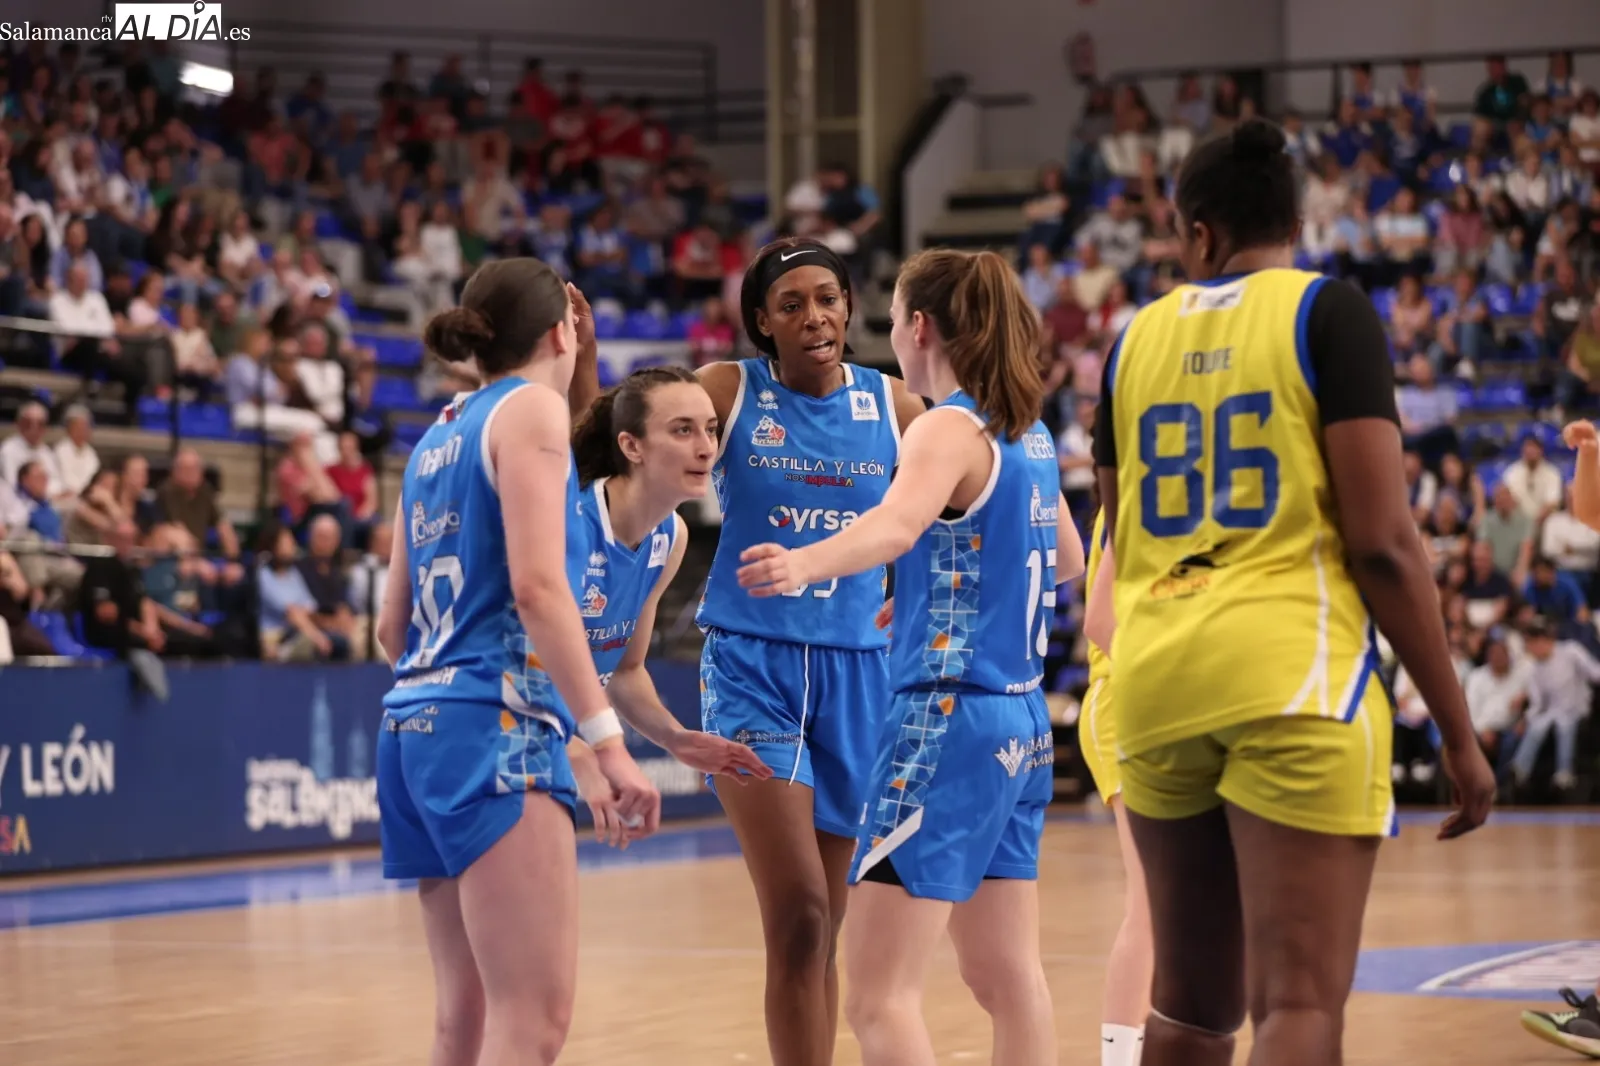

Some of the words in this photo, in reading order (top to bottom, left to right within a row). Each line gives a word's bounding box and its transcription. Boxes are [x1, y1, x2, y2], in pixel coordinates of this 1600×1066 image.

[748, 455, 825, 472] CASTILLA
[833, 461, 845, 476] Y
[850, 459, 885, 477] LEÓN
[1139, 390, 1280, 538] 86
[586, 624, 617, 640] STILLA
[21, 722, 115, 798] LEÓN
